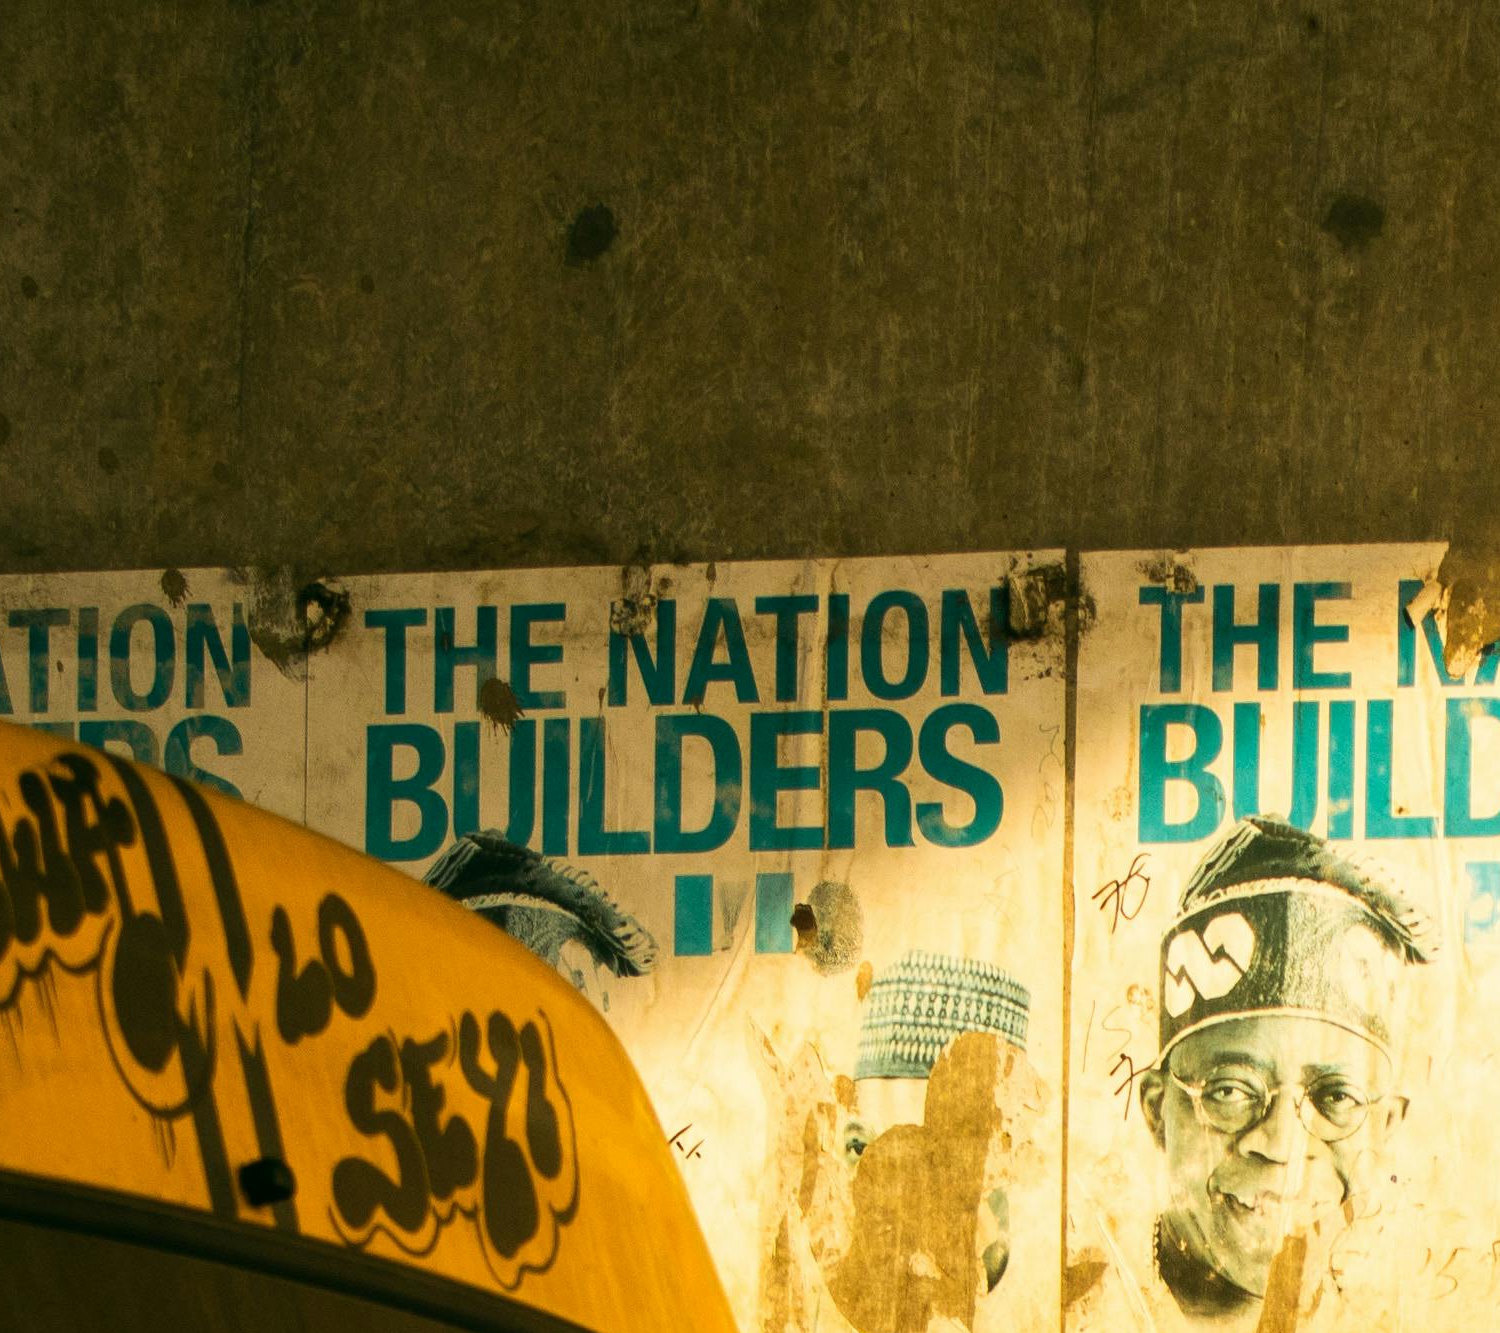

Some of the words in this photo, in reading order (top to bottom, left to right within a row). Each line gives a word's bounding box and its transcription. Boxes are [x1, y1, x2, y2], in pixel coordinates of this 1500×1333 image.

[365, 603, 566, 714] THE
[608, 588, 1009, 706] NATION
[1139, 581, 1352, 692] THE
[365, 704, 1003, 862] BUILDERS
